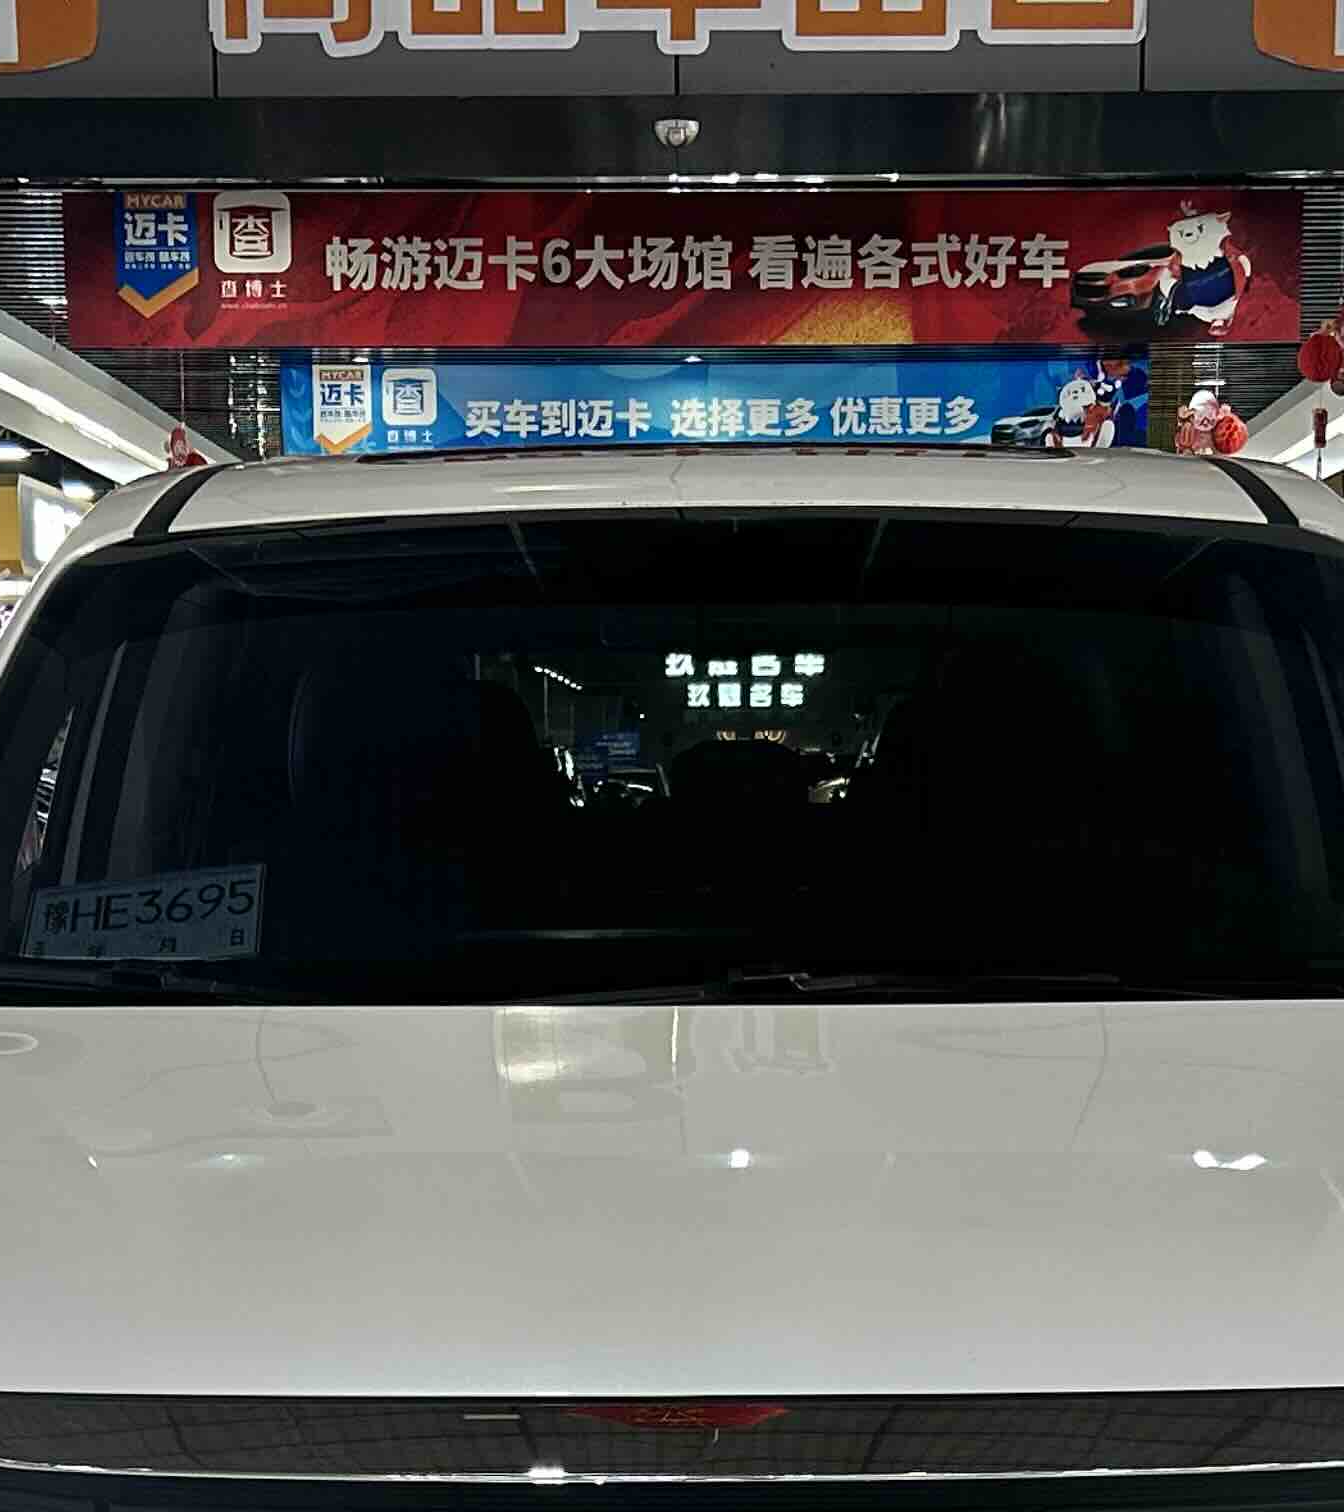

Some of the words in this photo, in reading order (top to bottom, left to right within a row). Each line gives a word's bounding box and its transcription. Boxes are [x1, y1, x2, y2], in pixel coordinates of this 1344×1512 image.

[126, 193, 186, 208] MYCAR
[124, 212, 189, 247] 迈卡
[325, 234, 733, 293] 畅游迈卡6大场馆
[748, 233, 1071, 291] 看遍各式好车
[321, 383, 364, 406] 迈卡
[464, 400, 652, 438] 买车到迈卡
[670, 398, 820, 438] 选择更多
[830, 396, 980, 437] 优惠更多
